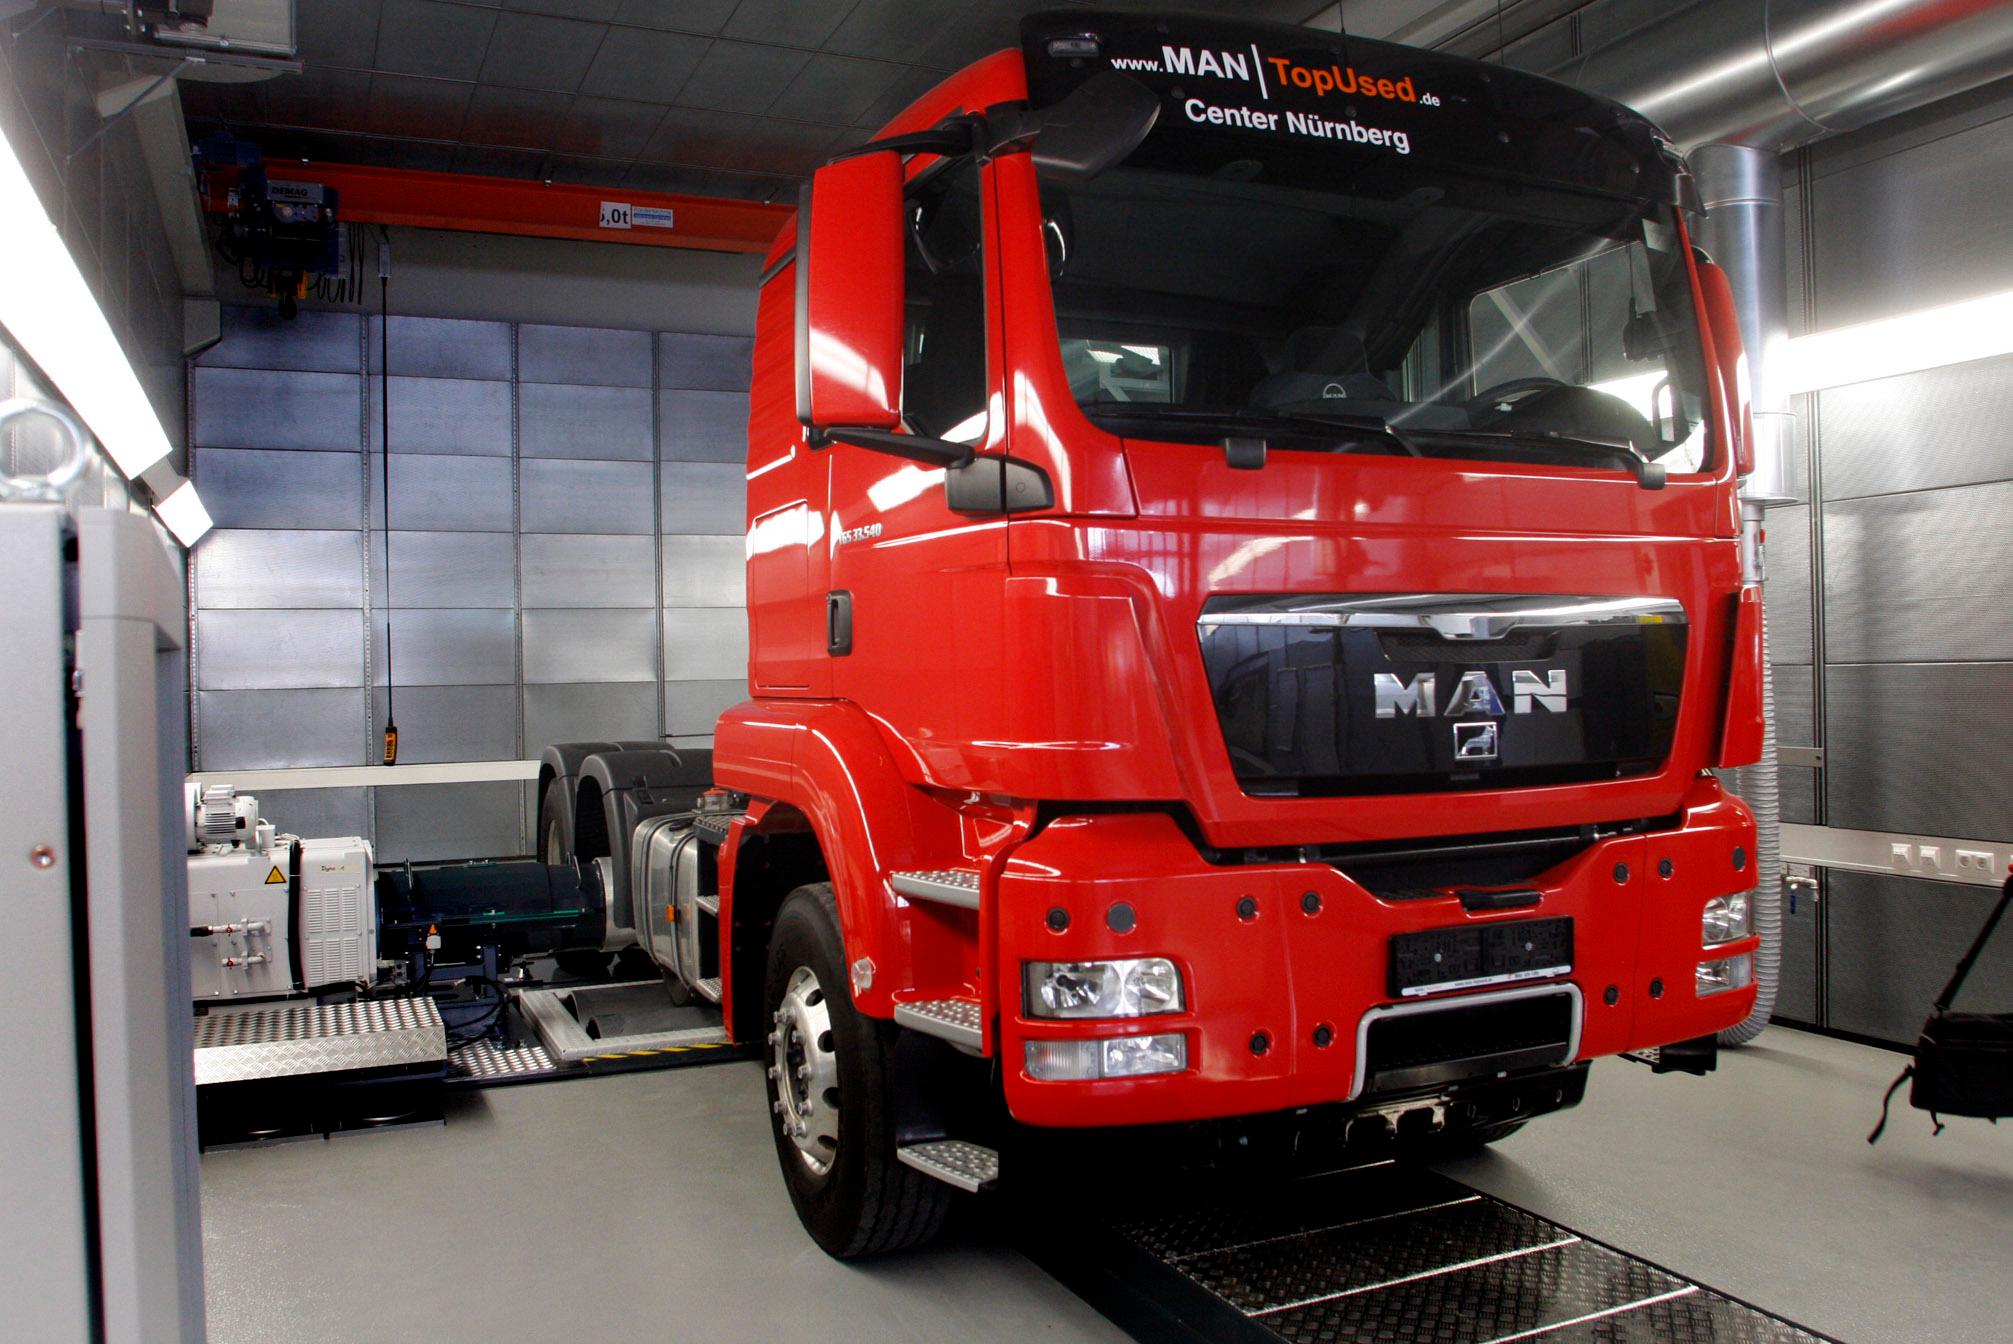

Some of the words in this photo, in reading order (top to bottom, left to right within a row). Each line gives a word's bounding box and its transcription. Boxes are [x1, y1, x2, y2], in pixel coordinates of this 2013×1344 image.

[1184, 98, 1279, 131] Center
[1285, 110, 1411, 155] Nürnberg
[271, 186, 308, 197] DEMAG
[1373, 669, 1568, 719] MAN
